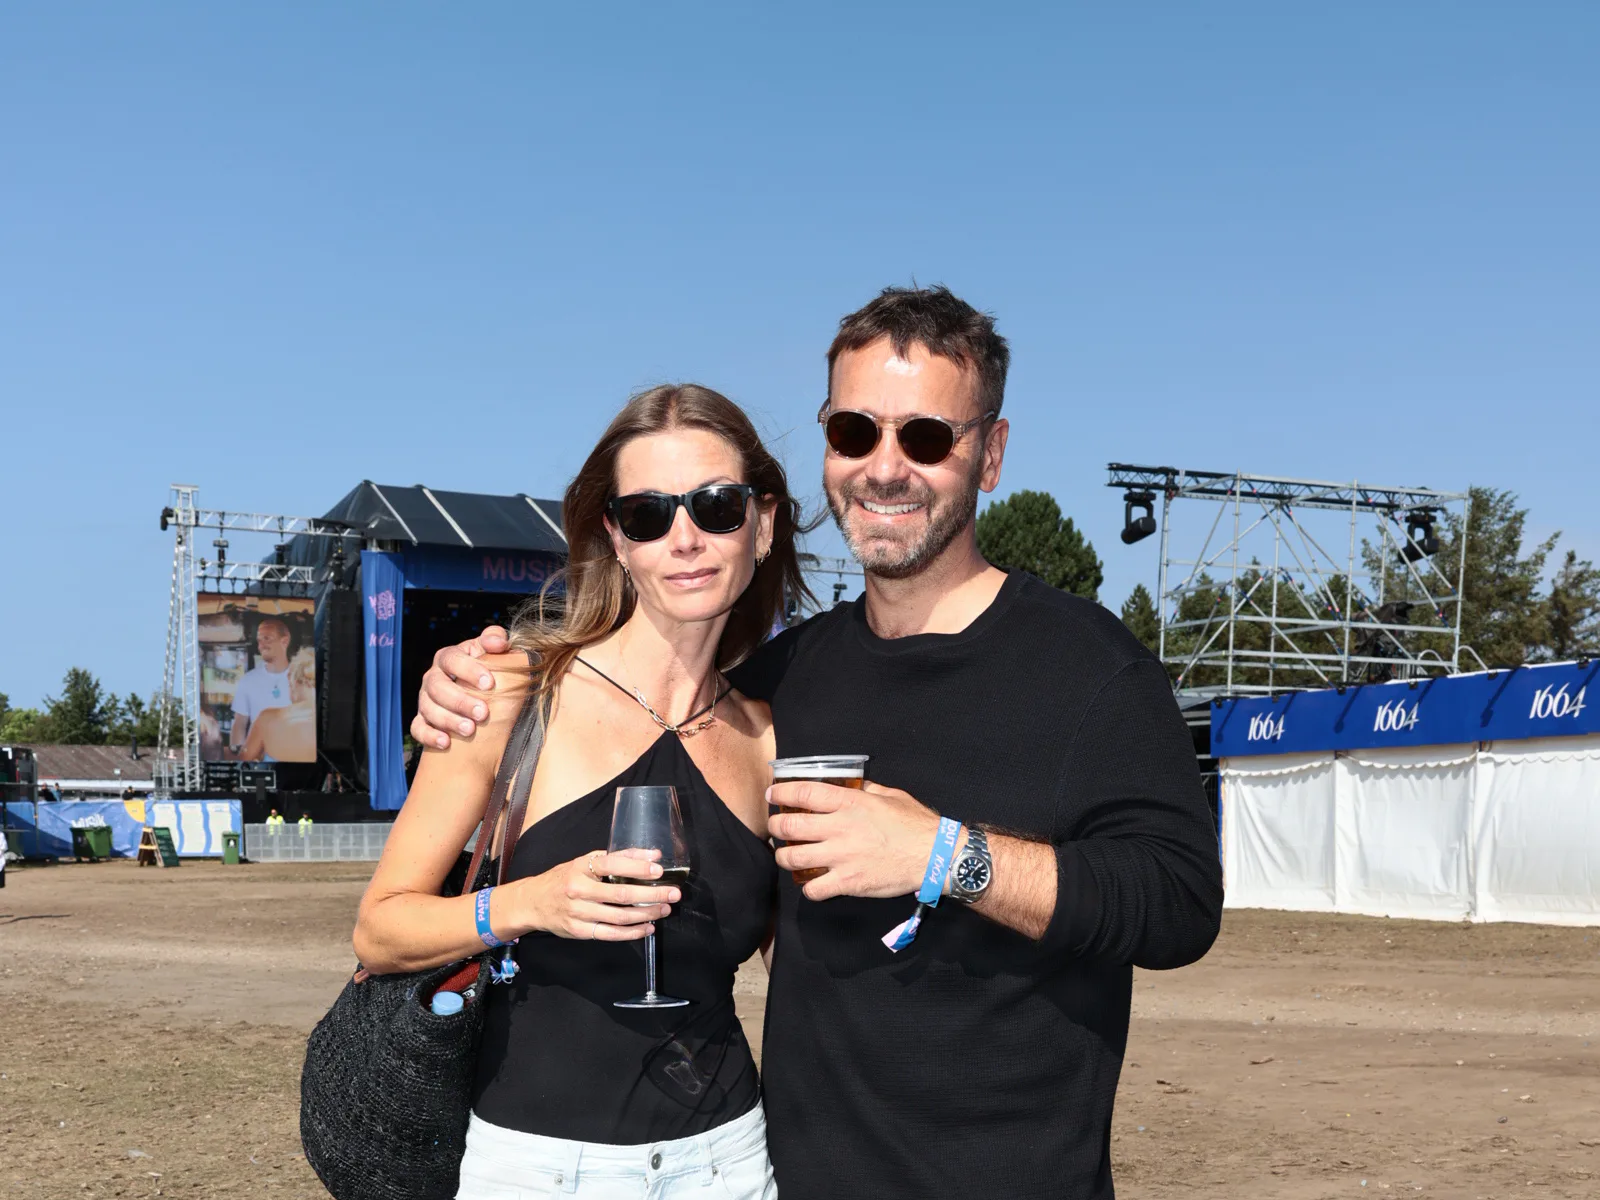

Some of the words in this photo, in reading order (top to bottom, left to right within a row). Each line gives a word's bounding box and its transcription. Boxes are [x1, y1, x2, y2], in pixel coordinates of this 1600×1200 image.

[483, 556, 553, 582] MUSI
[1374, 699, 1419, 732] 1664
[1529, 682, 1586, 719] 1664
[1248, 711, 1285, 741] 1664
[930, 854, 944, 884] 1664
